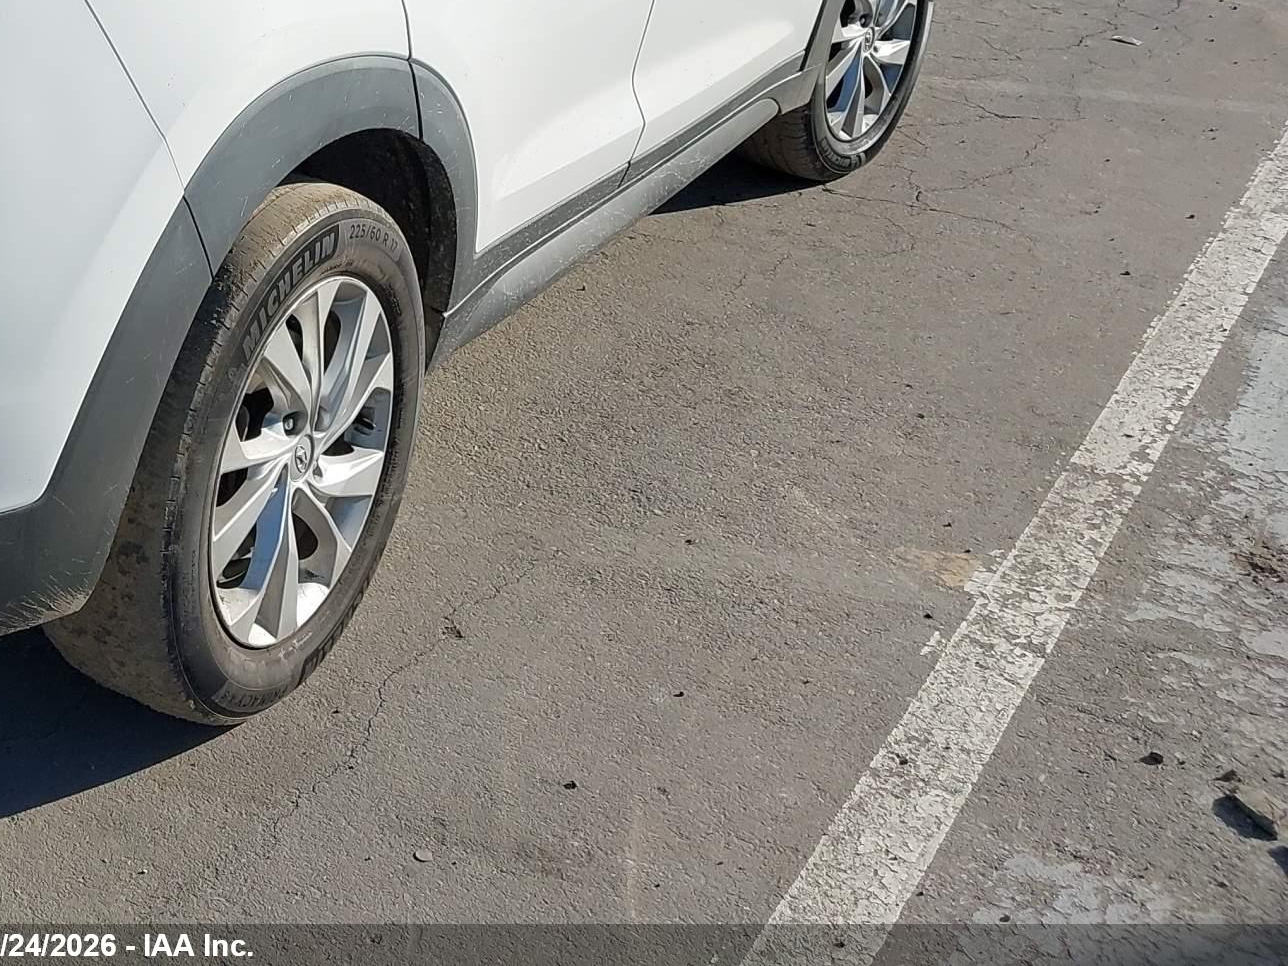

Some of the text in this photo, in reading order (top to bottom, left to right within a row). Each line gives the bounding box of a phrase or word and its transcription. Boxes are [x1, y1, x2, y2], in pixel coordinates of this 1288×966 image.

[349, 224, 399, 252] 225/60 R 17
[242, 232, 336, 360] MICHELIN
